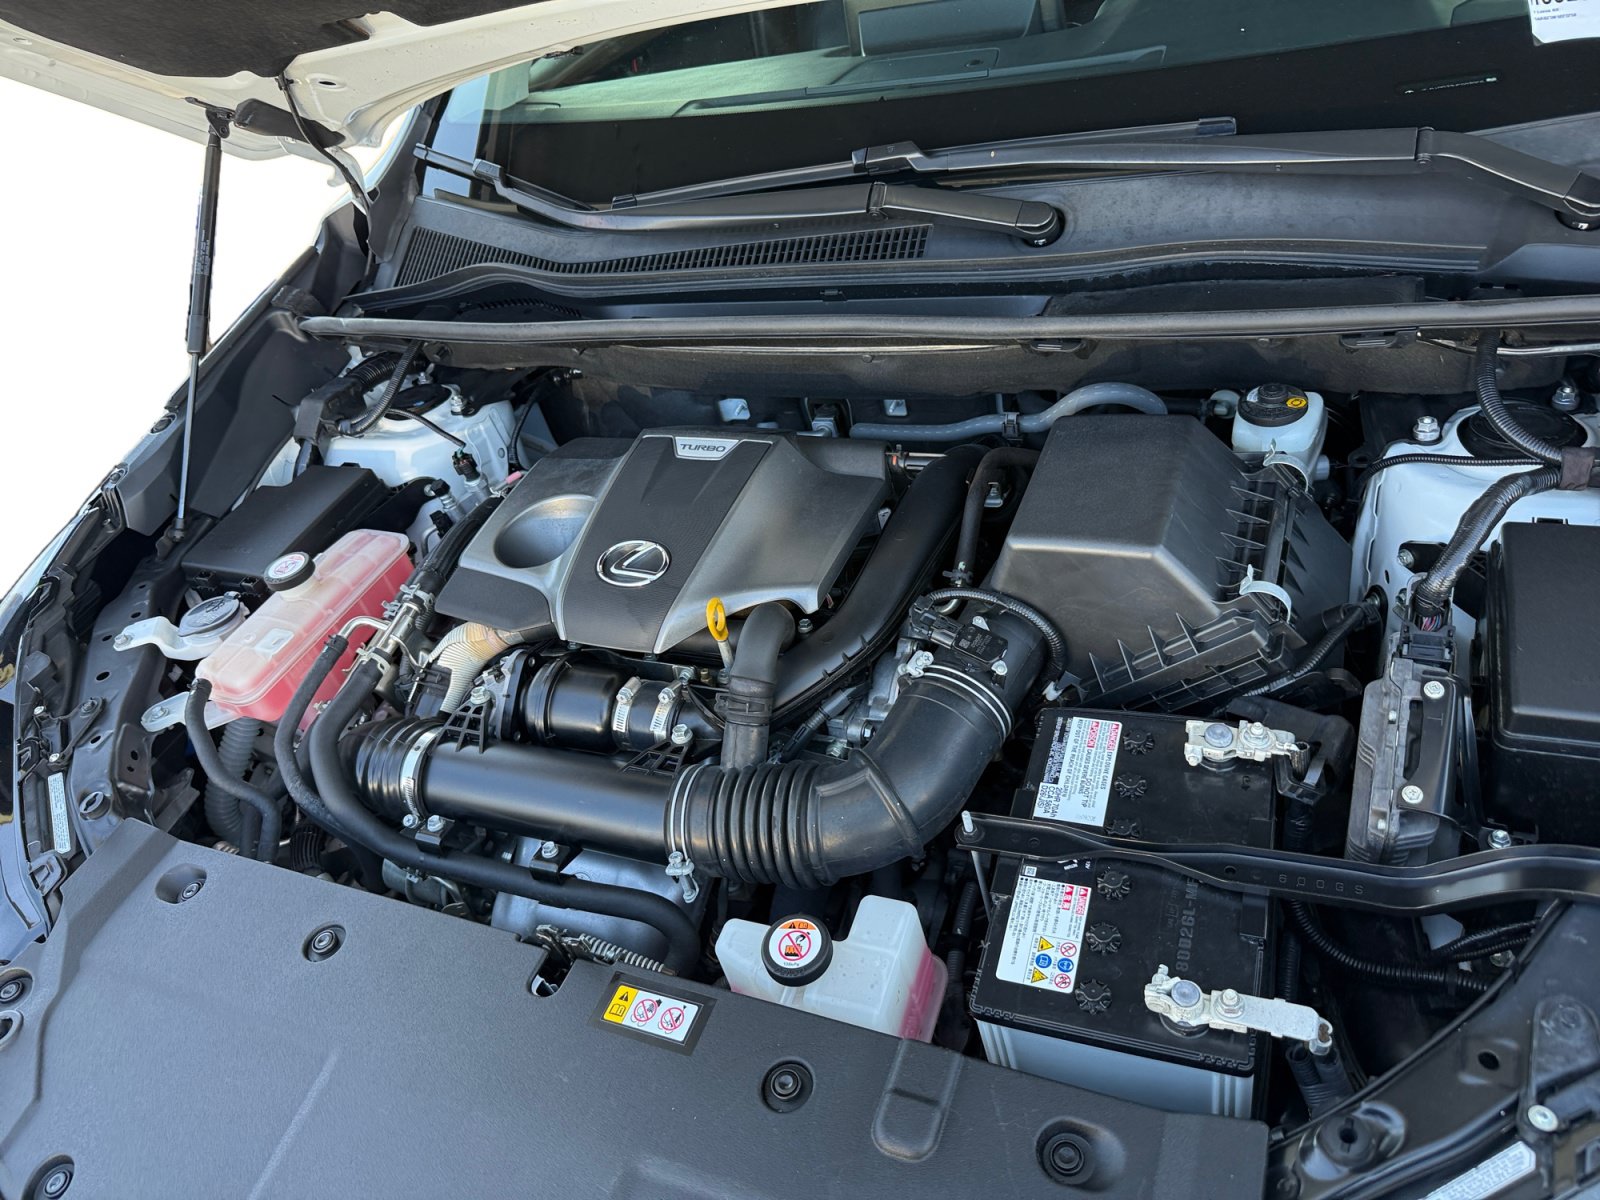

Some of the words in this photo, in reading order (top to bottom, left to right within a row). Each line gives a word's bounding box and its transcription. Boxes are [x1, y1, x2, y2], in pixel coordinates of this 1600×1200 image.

[680, 443, 727, 453] TURBO
[1087, 727, 1097, 746] POISON
[1107, 728, 1117, 750] DANGER
[1067, 753, 1075, 767] REACH
[1084, 749, 1092, 764] CAUSES
[1103, 751, 1112, 774] EXPLOSIVE
[1081, 764, 1089, 779] SEVERE
[1061, 775, 1071, 797] CHILDREN
[1077, 779, 1086, 794] BURNS
[1084, 778, 1092, 786] DO
[1100, 775, 1108, 789] GASES
[1046, 786, 1054, 798] CCA
[1054, 787, 1062, 802] 20HR
[1082, 786, 1090, 797] NOT
[1043, 799, 1052, 814] 580A
[1049, 802, 1058, 817] 70Ah
